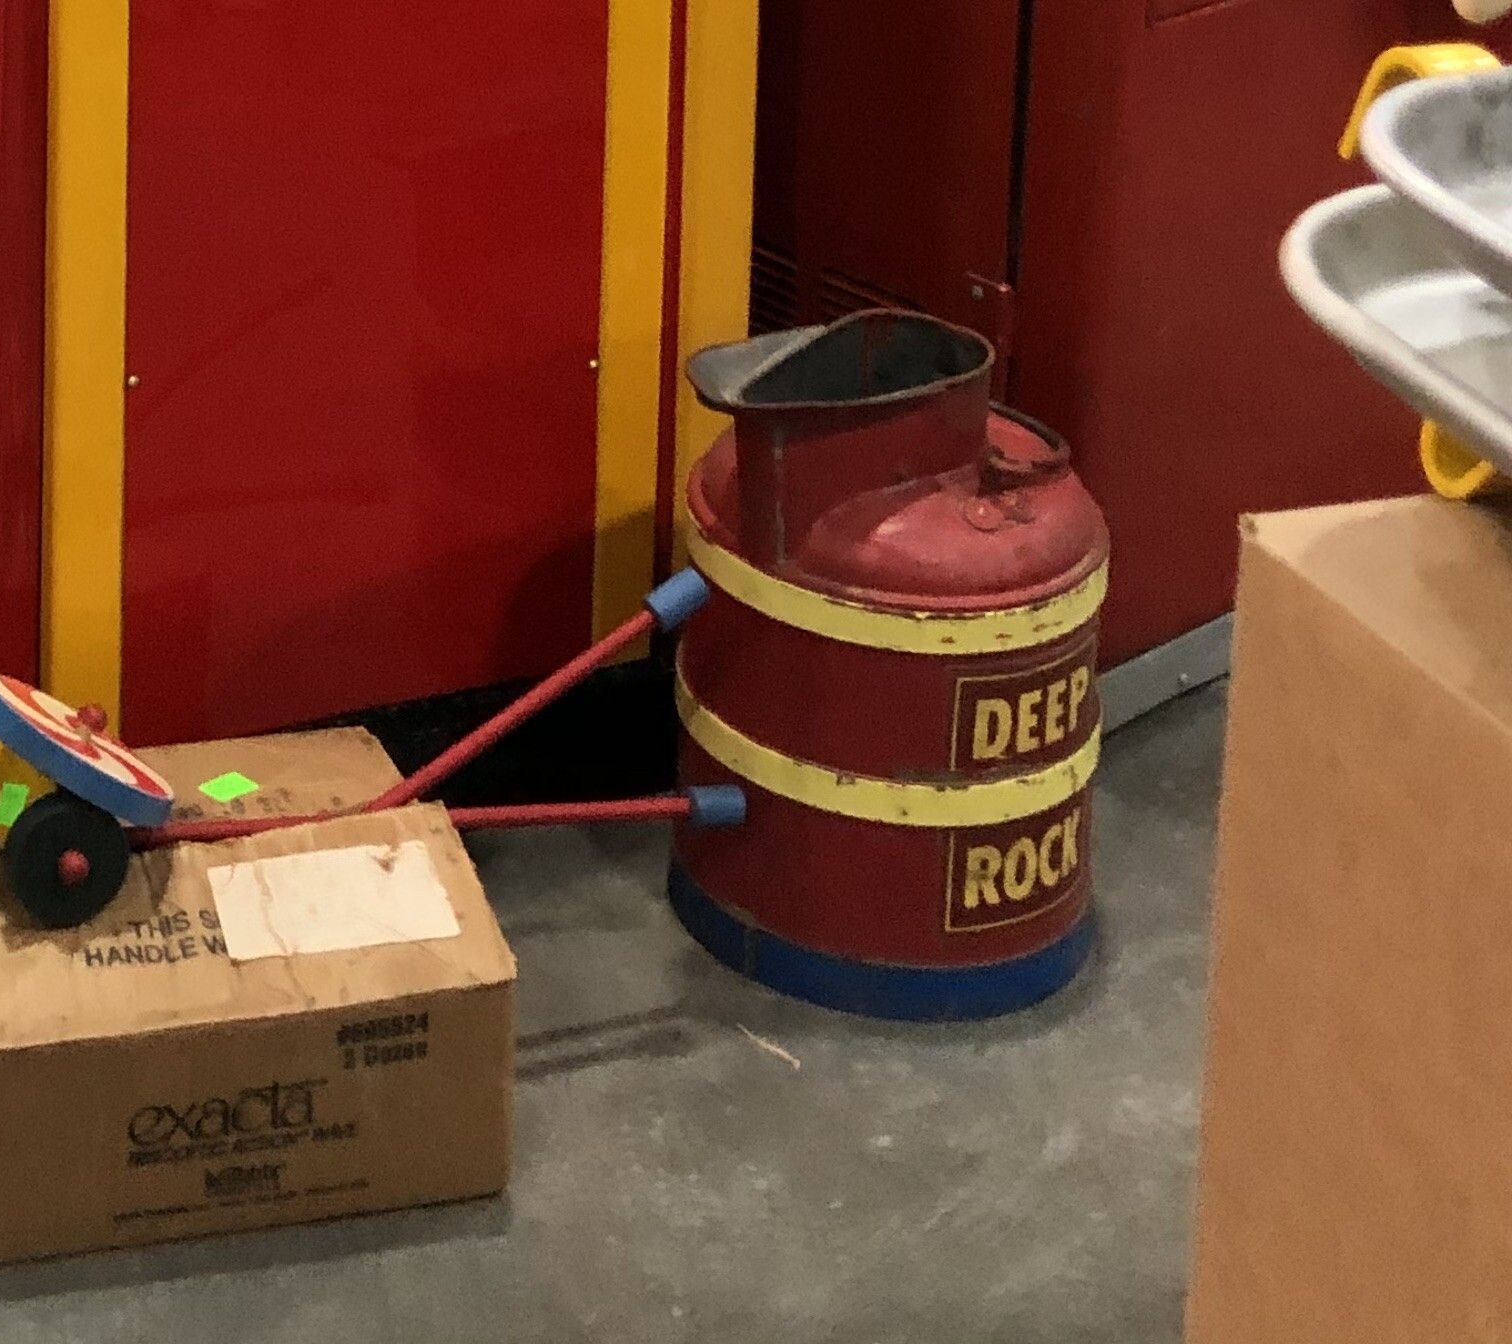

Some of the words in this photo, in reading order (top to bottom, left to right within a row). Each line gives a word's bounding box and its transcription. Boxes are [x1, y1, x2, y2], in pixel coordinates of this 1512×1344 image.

[971, 665, 1089, 761] DEEP
[963, 812, 1079, 909] ROCK
[83, 935, 198, 968] HANDLE
[128, 909, 192, 940] THIS
